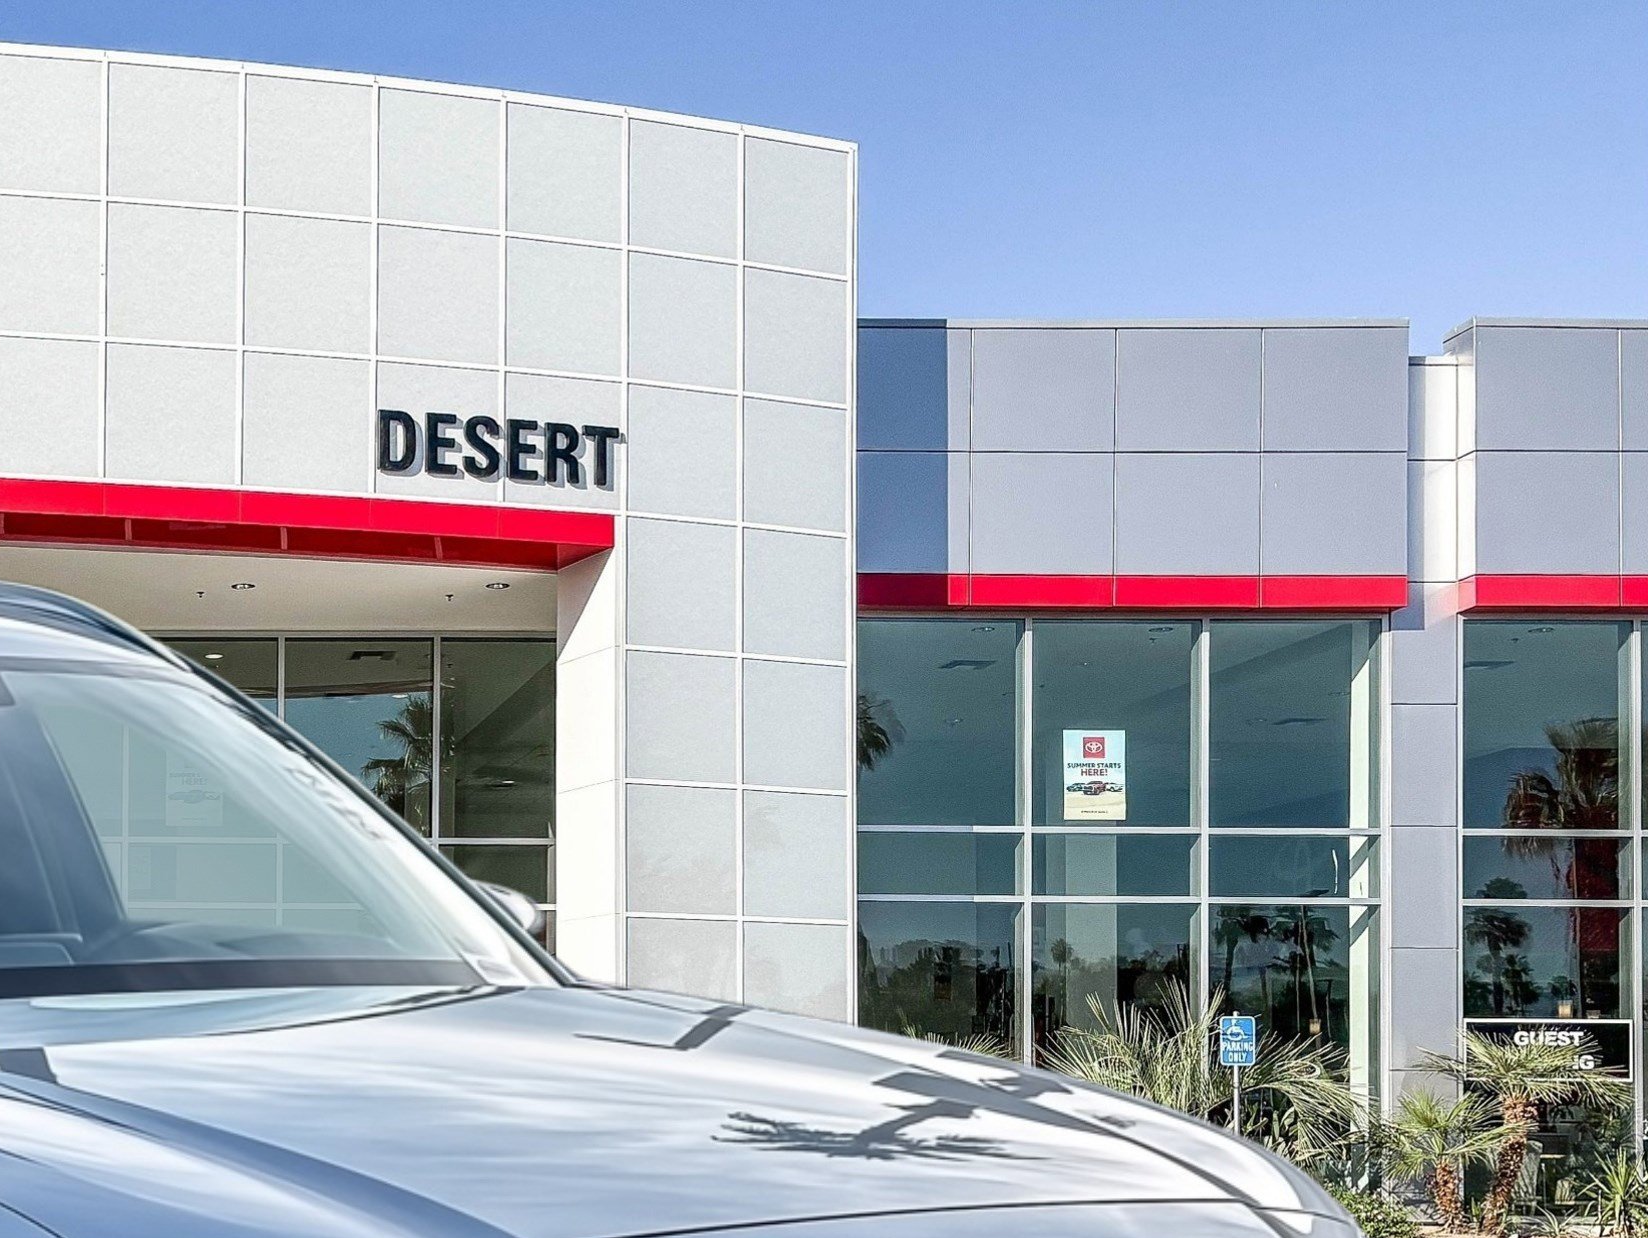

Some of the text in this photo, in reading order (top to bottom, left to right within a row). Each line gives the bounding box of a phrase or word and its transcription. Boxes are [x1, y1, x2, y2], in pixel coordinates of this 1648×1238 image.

[377, 409, 620, 487] DESERT
[1513, 1030, 1585, 1046] GUEST
[1223, 1042, 1253, 1052] PARKING
[1228, 1051, 1248, 1062] ONLY
